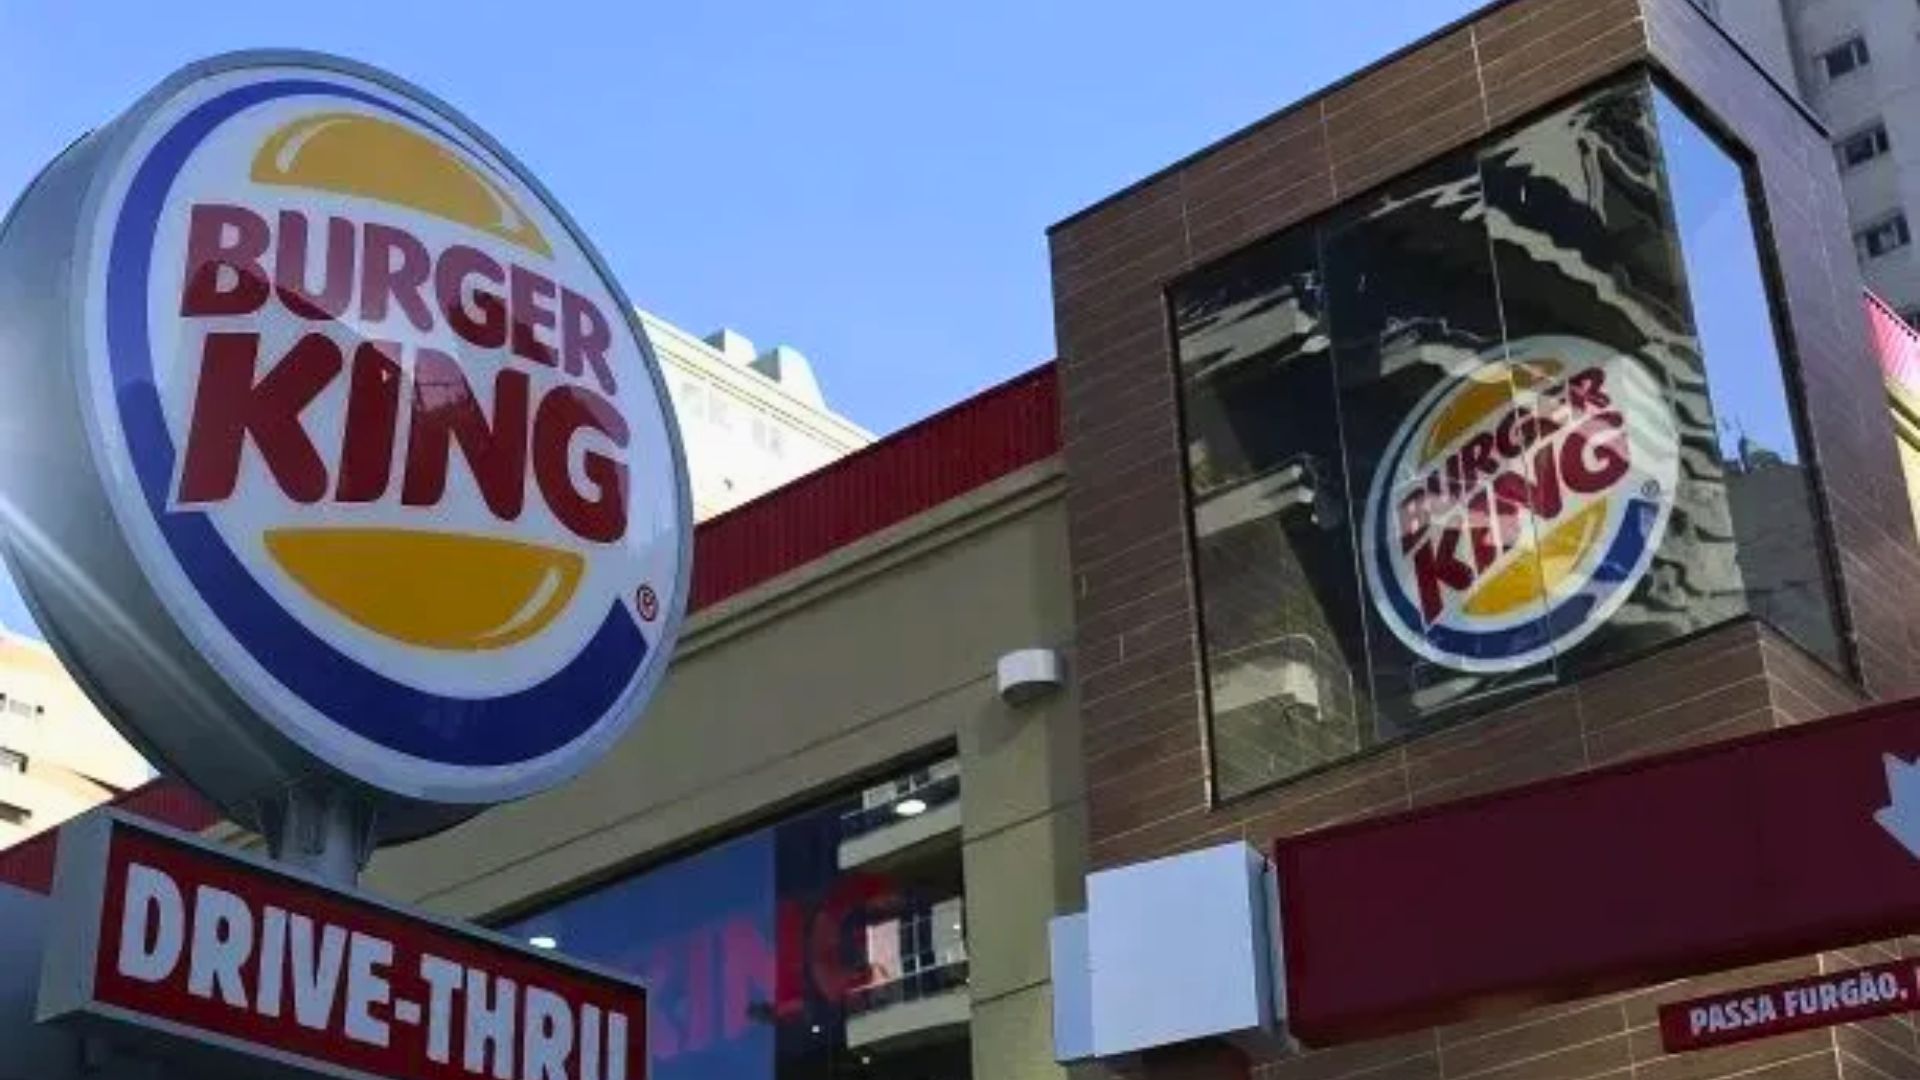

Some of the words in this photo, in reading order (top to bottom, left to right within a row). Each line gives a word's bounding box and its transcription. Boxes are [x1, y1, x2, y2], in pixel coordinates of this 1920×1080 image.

[180, 203, 617, 396] BURGER
[178, 332, 629, 544] KING
[1400, 367, 1611, 556] BURGER
[1414, 410, 1630, 624] KING
[118, 861, 628, 1080] DRIVE-THRU
[1690, 995, 1777, 1035] PASSA
